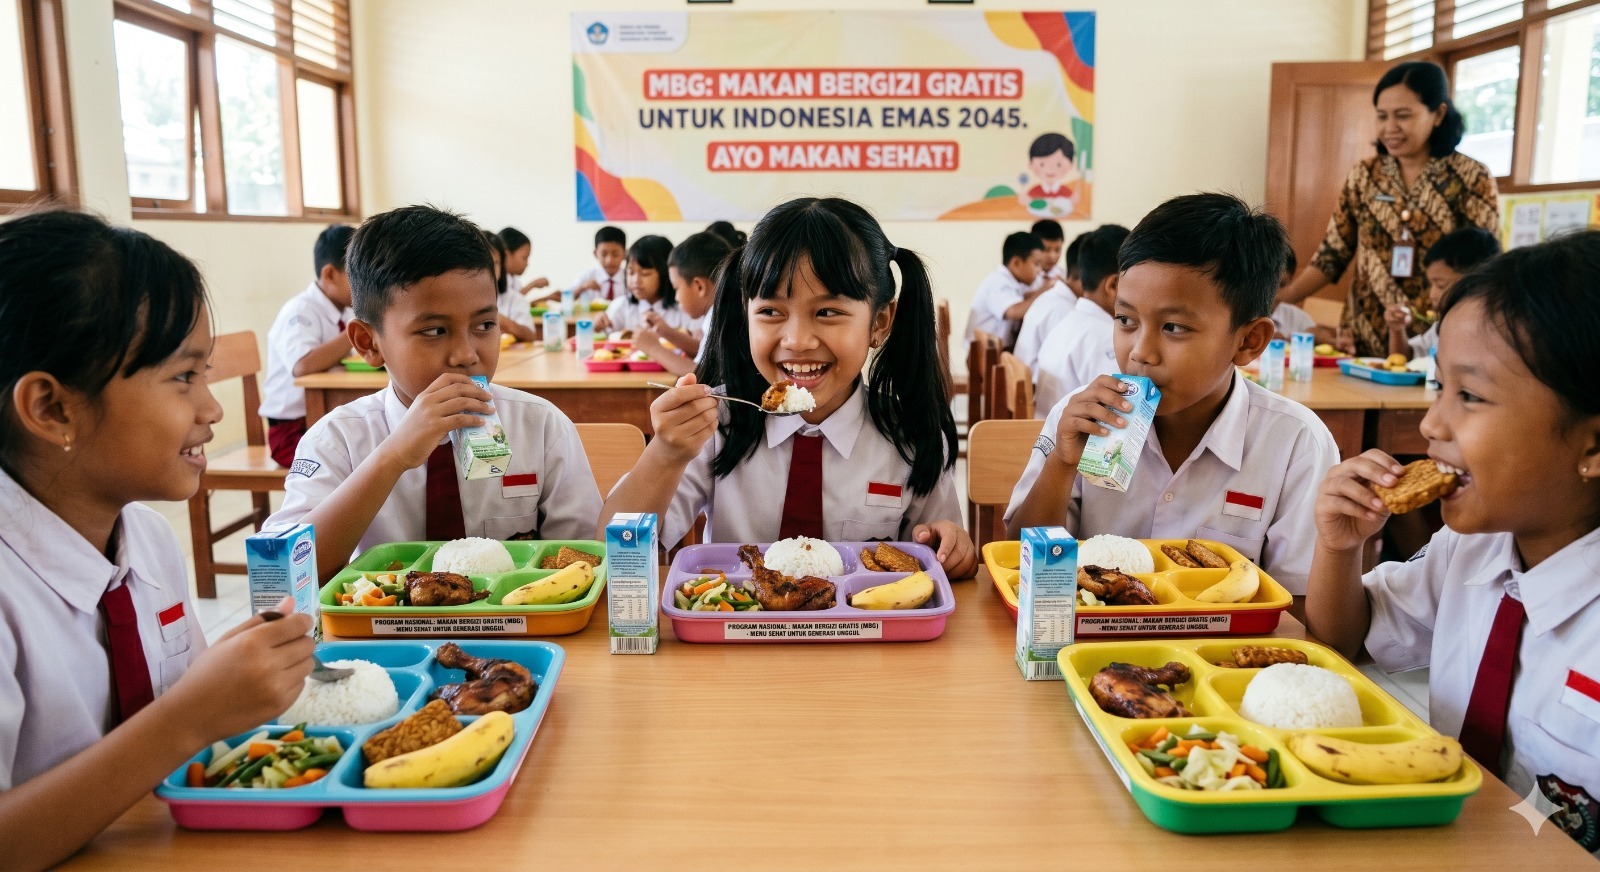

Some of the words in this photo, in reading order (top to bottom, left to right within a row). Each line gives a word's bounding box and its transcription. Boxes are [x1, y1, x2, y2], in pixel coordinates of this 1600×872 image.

[649, 72, 713, 97] MBG:
[718, 72, 814, 96] MAKAN
[820, 72, 920, 96] BERGIZI
[926, 72, 1018, 97] GRATIS
[639, 108, 726, 128] UNTUK
[734, 107, 872, 128] INDONESIA
[882, 107, 950, 128] EMAS
[958, 107, 1028, 128] 2045.
[712, 145, 763, 168] AYO
[768, 144, 861, 168] MAKAN
[866, 144, 954, 168] SEHAT!
